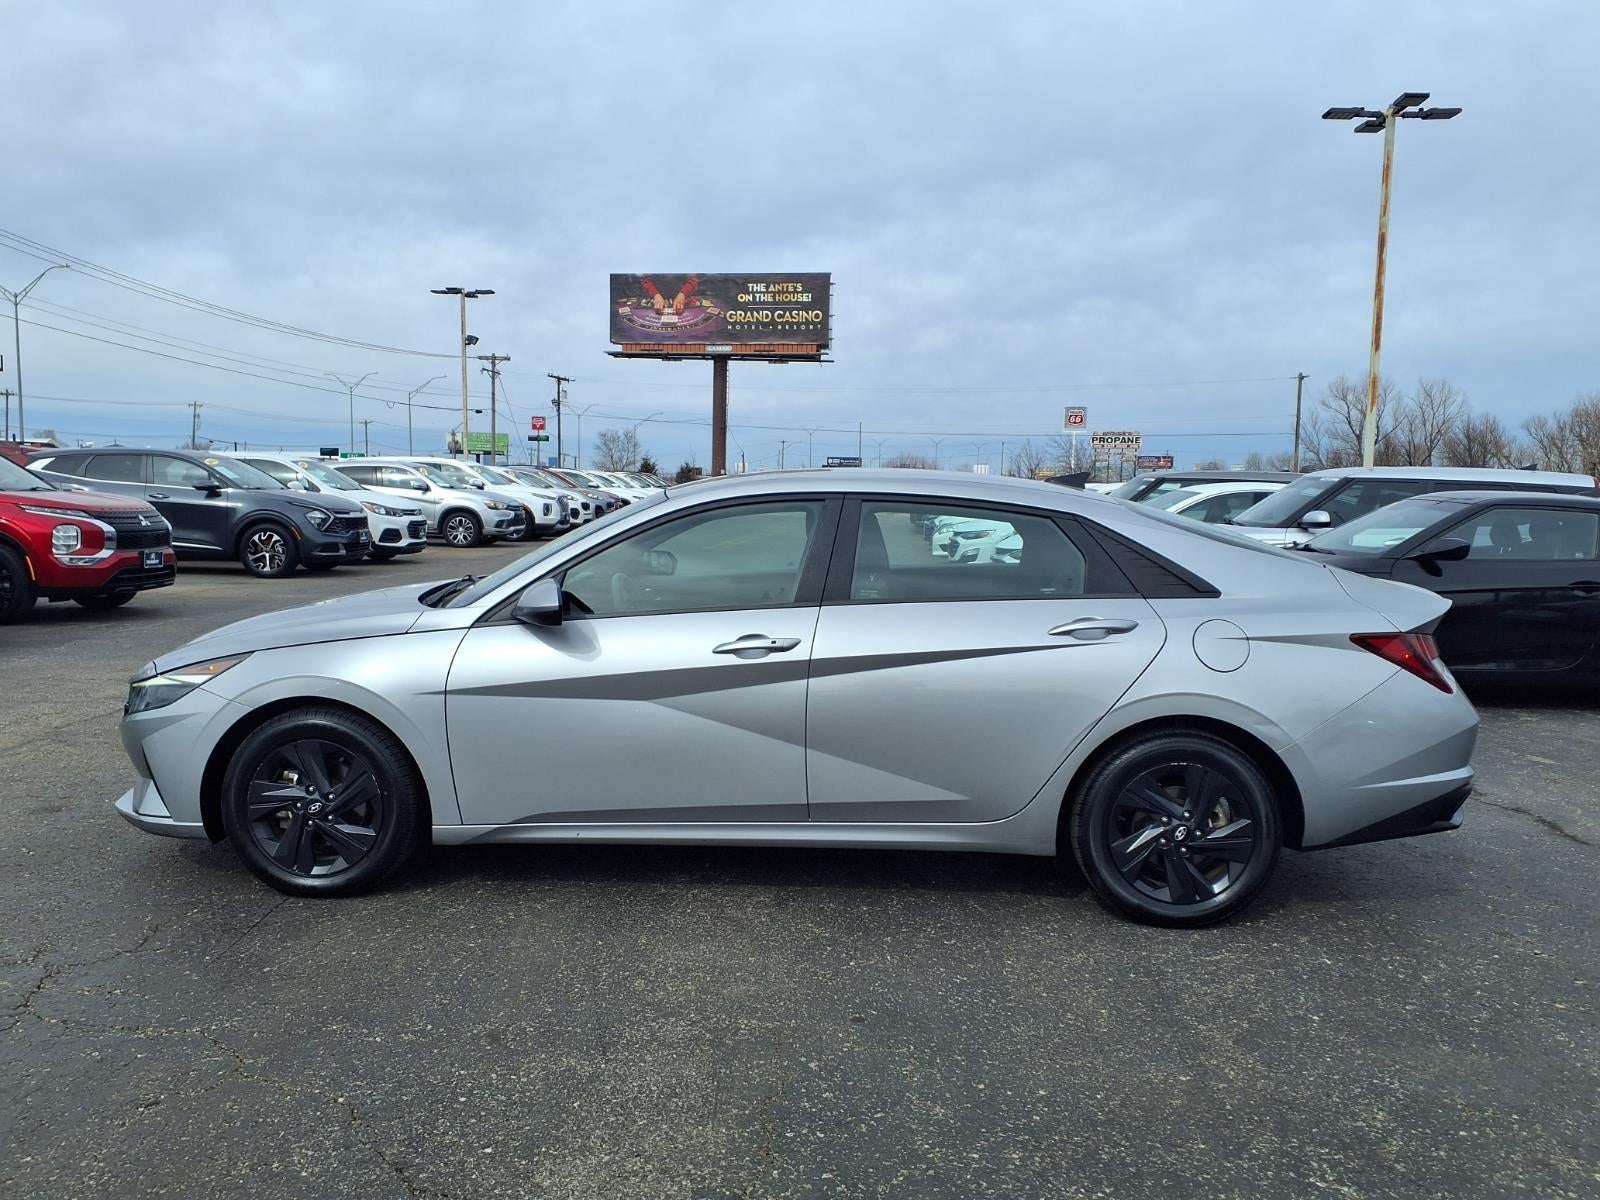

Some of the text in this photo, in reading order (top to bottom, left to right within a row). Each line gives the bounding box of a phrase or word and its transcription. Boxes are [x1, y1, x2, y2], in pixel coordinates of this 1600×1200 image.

[747, 283, 803, 292] THE ANTE'S
[737, 293, 812, 302] ON THE HOUSE!
[726, 310, 823, 322] GRAND CASINO
[1069, 415, 1082, 423] 66
[1091, 436, 1141, 444] PROPANE
